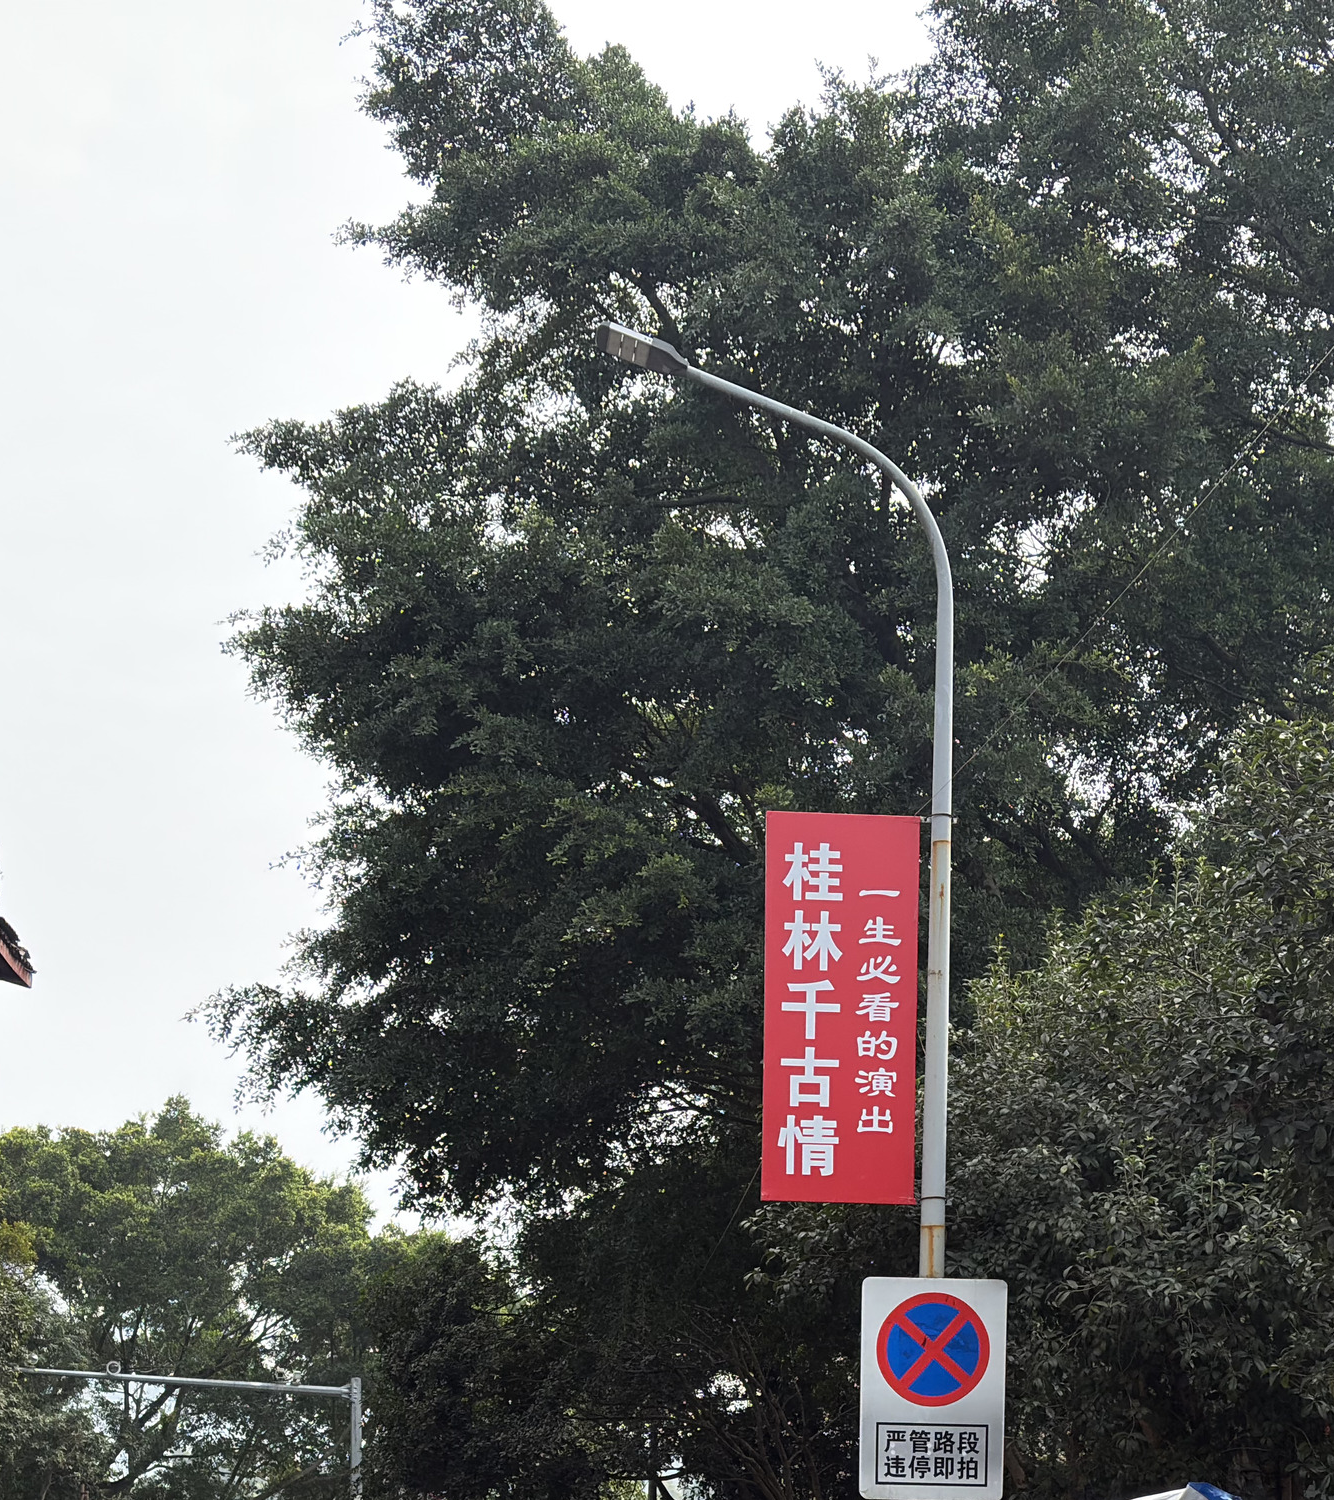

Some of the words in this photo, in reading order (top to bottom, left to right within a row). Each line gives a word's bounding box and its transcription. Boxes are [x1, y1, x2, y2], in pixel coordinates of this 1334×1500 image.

[777, 841, 844, 1179] 桂林千古情
[854, 888, 902, 1135] 一生必看的演出
[883, 1455, 979, 1481] 违停即拍
[884, 1429, 980, 1455] 严管路段
